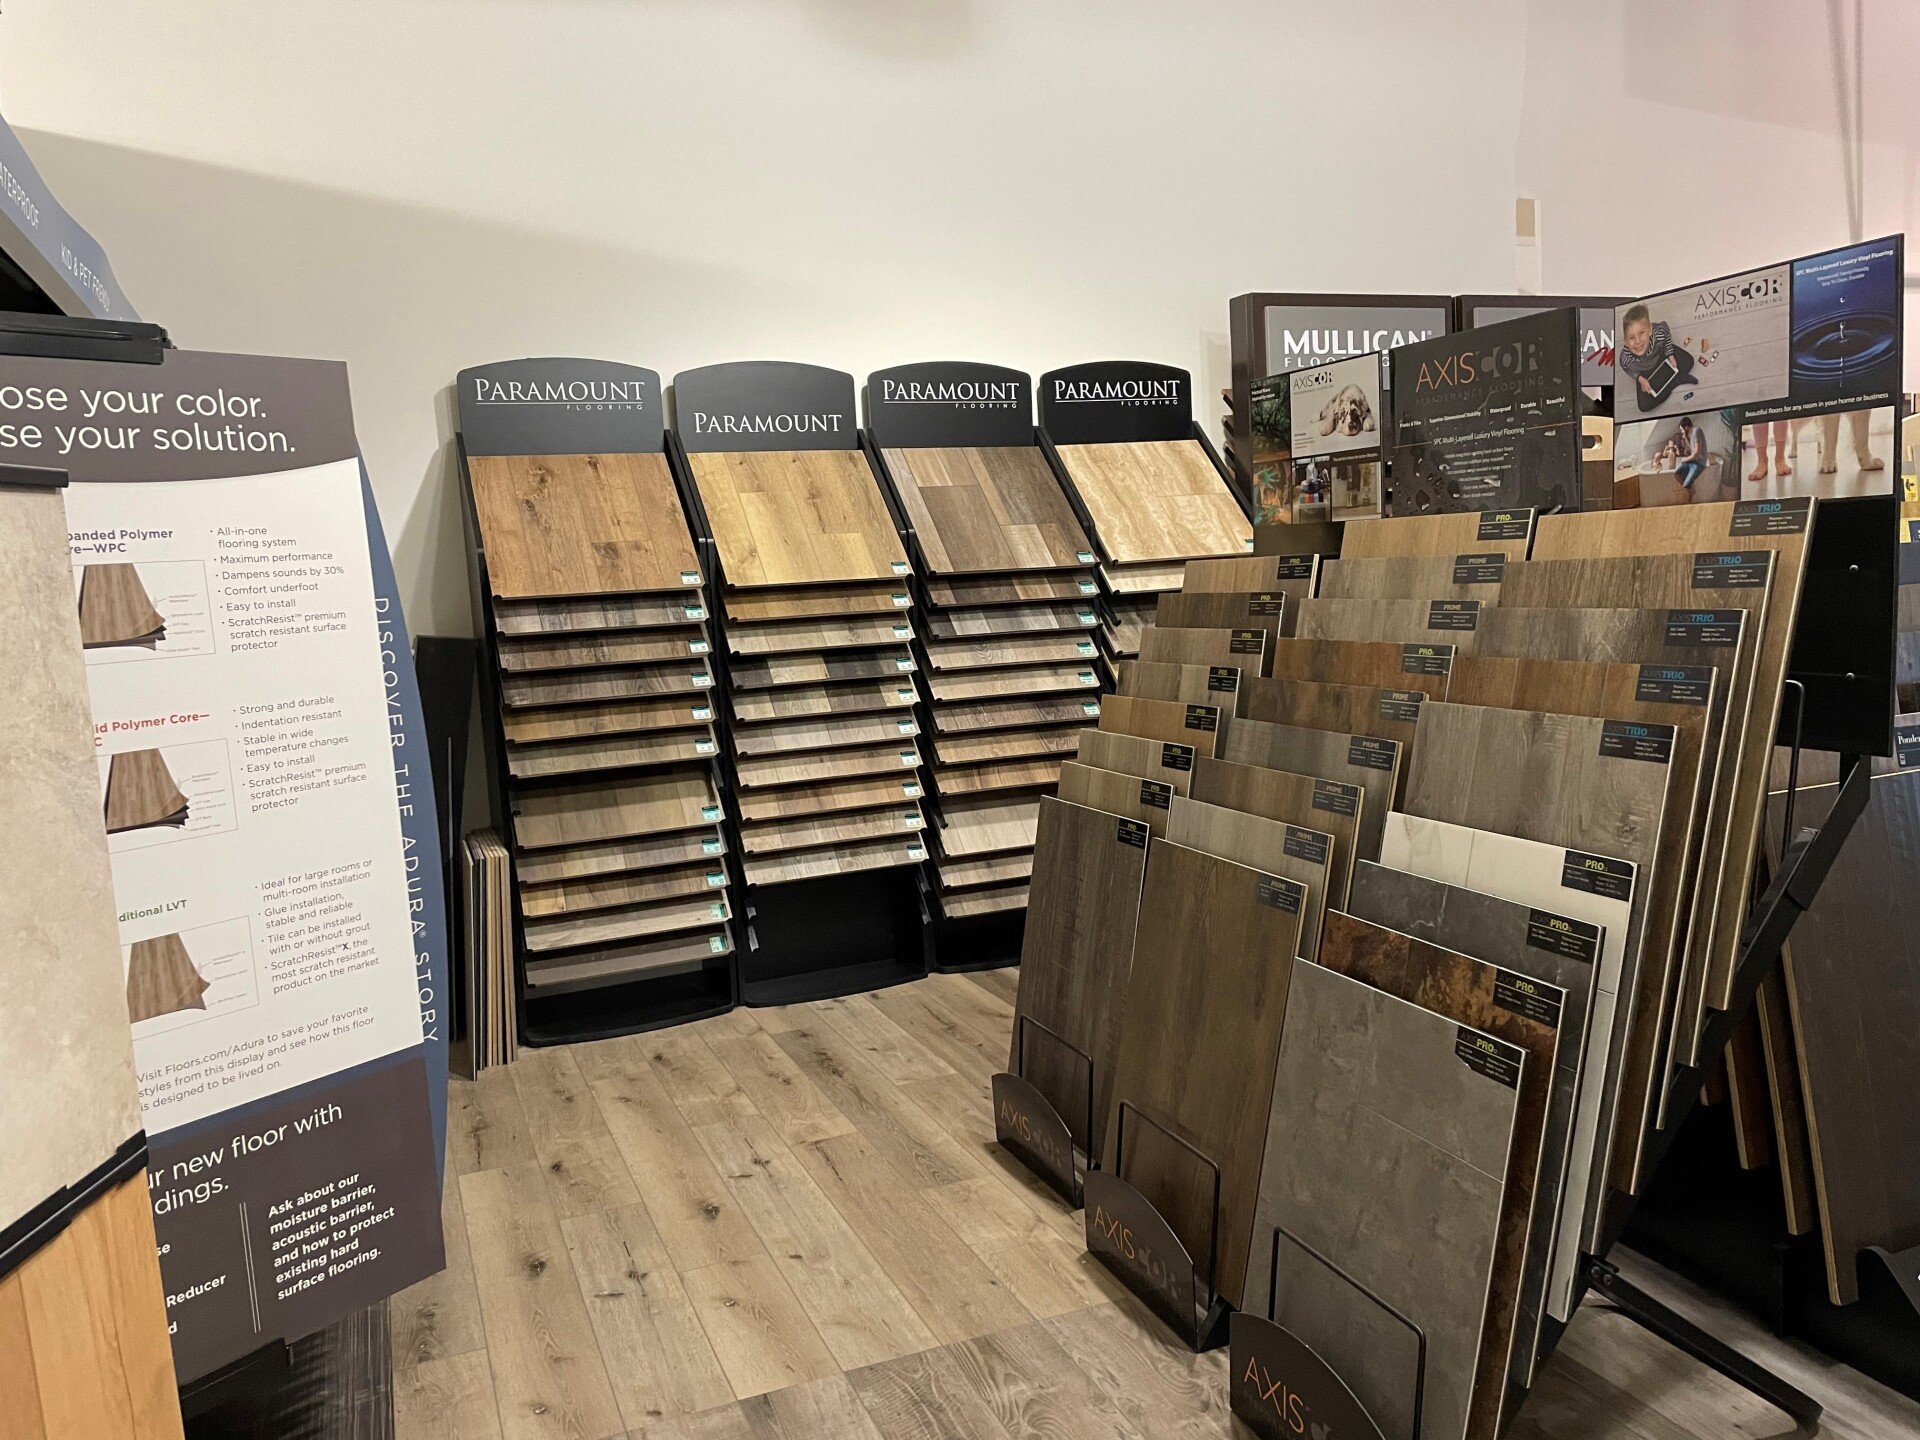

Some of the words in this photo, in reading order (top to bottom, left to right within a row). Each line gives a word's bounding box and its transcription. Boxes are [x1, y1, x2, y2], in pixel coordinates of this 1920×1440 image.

[61, 244, 72, 270] KID
[74, 257, 78, 276] &
[80, 263, 91, 288] PET
[1858, 254, 1871, 262] Vinyl
[1872, 250, 1893, 259] Flooring
[1694, 307, 1742, 320] PERFORMANCE
[1746, 297, 1783, 309] FLOORING
[81, 390, 163, 416] your
[176, 390, 267, 418] color.
[1745, 407, 1767, 417] Beautiful
[1769, 405, 1783, 415] floors
[1793, 404, 1802, 412] any
[1803, 401, 1818, 409] room
[1825, 399, 1837, 408] your
[1838, 396, 1855, 405] home
[1863, 391, 1888, 402] business
[56, 425, 140, 454] your
[153, 423, 295, 452] solution.
[1443, 433, 1473, 443] Multi-Layered
[1474, 432, 1490, 440] Luxury
[1491, 429, 1503, 437] Vinyl
[1504, 427, 1524, 435] Flooring
[120, 529, 173, 540] Polymer
[217, 527, 267, 536] All-in-one
[219, 540, 259, 548] flooring
[262, 538, 296, 548] system
[221, 556, 269, 564] Maximum
[273, 552, 332, 563] performance
[223, 571, 270, 580] Dampens
[273, 567, 307, 577] sounds
[310, 567, 321, 576] by
[325, 566, 344, 575] 30%
[225, 585, 267, 596] Comfort
[271, 583, 319, 593] underfoot
[227, 602, 250, 612] Easy
[254, 601, 264, 609] to
[268, 599, 295, 608] install
[304, 611, 346, 622] premium
[230, 629, 266, 639] scratch
[270, 625, 309, 636] resistant
[313, 623, 346, 633] surface
[232, 641, 278, 652] protector
[240, 704, 274, 714] Strong
[277, 701, 295, 710] and
[298, 696, 334, 707] durable
[112, 717, 166, 732] Polymer
[242, 717, 299, 730] Indentation
[302, 710, 342, 721] resistant
[244, 733, 275, 745] Stable
[279, 732, 287, 740] in
[290, 729, 314, 739] wide
[246, 742, 307, 757] temperature
[310, 736, 349, 748] changes
[247, 762, 270, 772] Easy
[274, 760, 284, 768] to
[287, 755, 315, 766] install
[325, 763, 366, 776] premium
[251, 787, 287, 800] scratch
[290, 779, 330, 793] resistant
[333, 774, 367, 786] surface
[375, 598, 406, 747] DISCOVER
[415, 952, 439, 1041] STORY
[261, 878, 285, 890] Ideal
[288, 875, 302, 884] for
[305, 869, 328, 880] large
[332, 863, 360, 874] rooms
[263, 883, 317, 902] multi-room
[320, 871, 370, 889] installation
[166, 900, 187, 912] LVT
[265, 905, 287, 917] Glue
[290, 892, 344, 911] installation,
[353, 938, 368, 947] the
[137, 1068, 163, 1083] Visit
[166, 1037, 264, 1075] Floors.com/Adura
[268, 1033, 278, 1043] to
[281, 1026, 304, 1038] save
[306, 1018, 329, 1032] your
[331, 1005, 368, 1023] favorite
[172, 1148, 224, 1180] new
[231, 1124, 288, 1158] floor
[294, 1102, 342, 1134] with
[268, 1200, 294, 1218] Ask
[297, 1183, 335, 1206] about
[338, 1172, 360, 1188] our
[270, 1203, 328, 1234] moisture
[331, 1183, 376, 1208] barrier,
[271, 1221, 327, 1250] acoustic
[330, 1201, 375, 1226] barrier,
[274, 1248, 298, 1268] and
[302, 1236, 329, 1254] how
[333, 1230, 347, 1242] to
[350, 1206, 395, 1236] protect
[276, 1252, 328, 1283] existing
[331, 1238, 360, 1256] hard
[278, 1271, 325, 1300] surface
[328, 1250, 381, 1278] flooring.
[166, 1274, 226, 1308] Reducer
